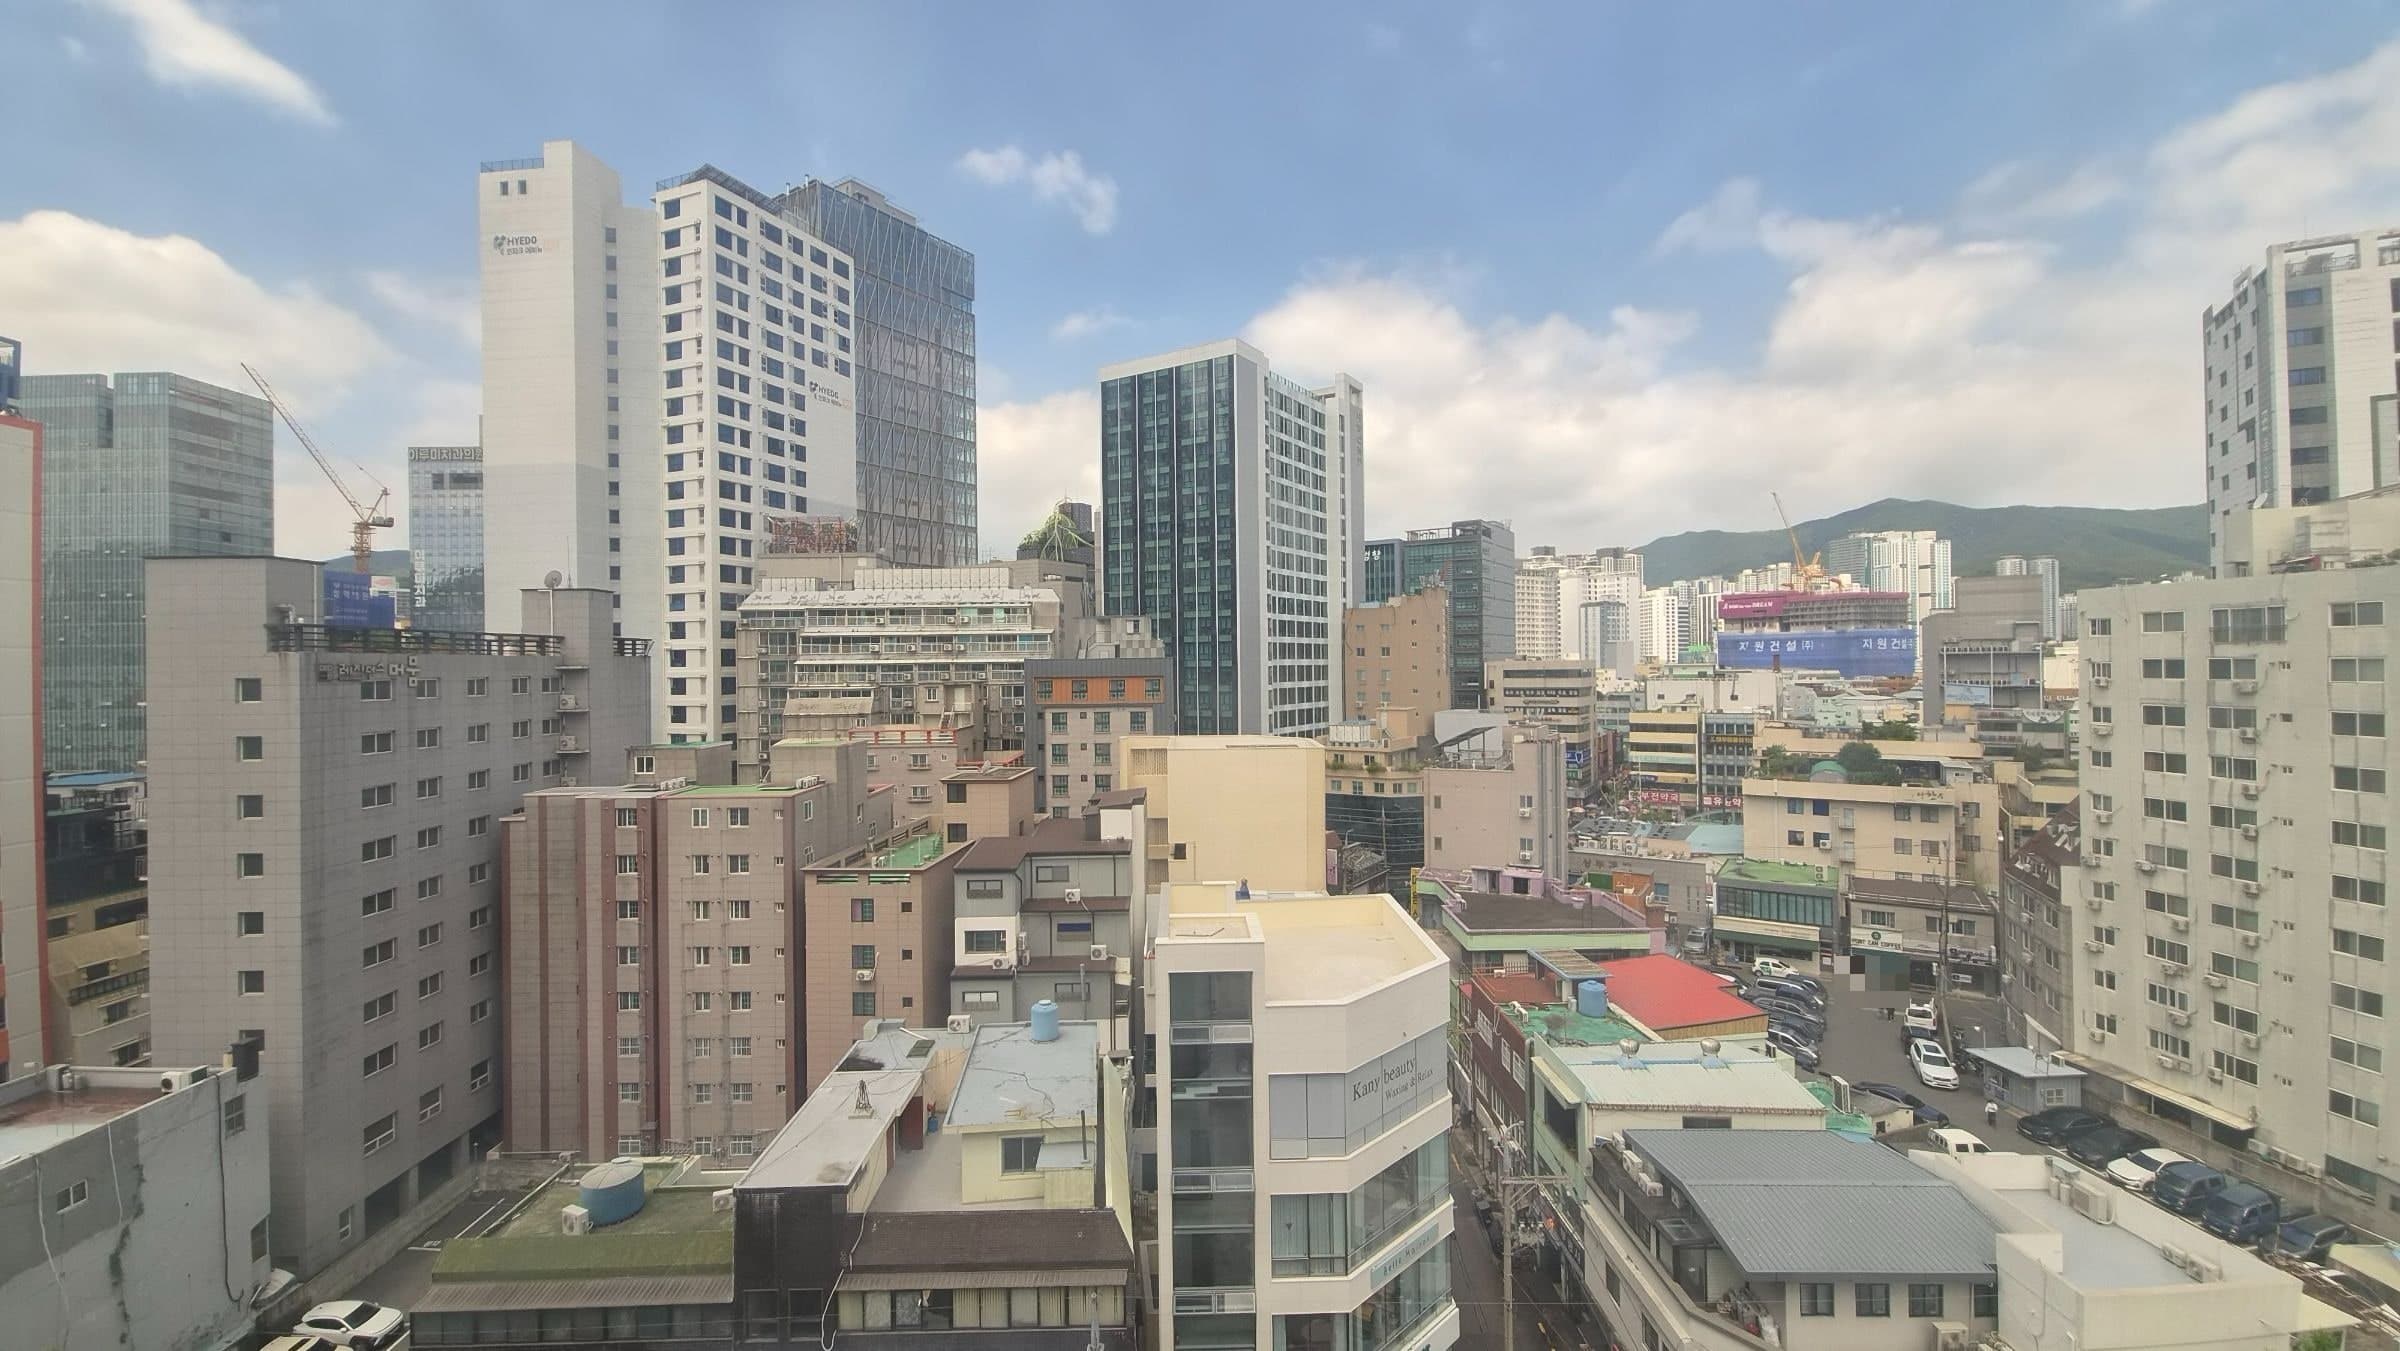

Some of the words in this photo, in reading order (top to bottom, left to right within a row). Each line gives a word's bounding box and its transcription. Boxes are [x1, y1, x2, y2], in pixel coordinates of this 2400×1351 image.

[507, 235, 537, 246] HYEDO
[818, 386, 839, 400] HYEDO
[1353, 1075, 1381, 1101] Kany
[1383, 1057, 1416, 1084] beauty
